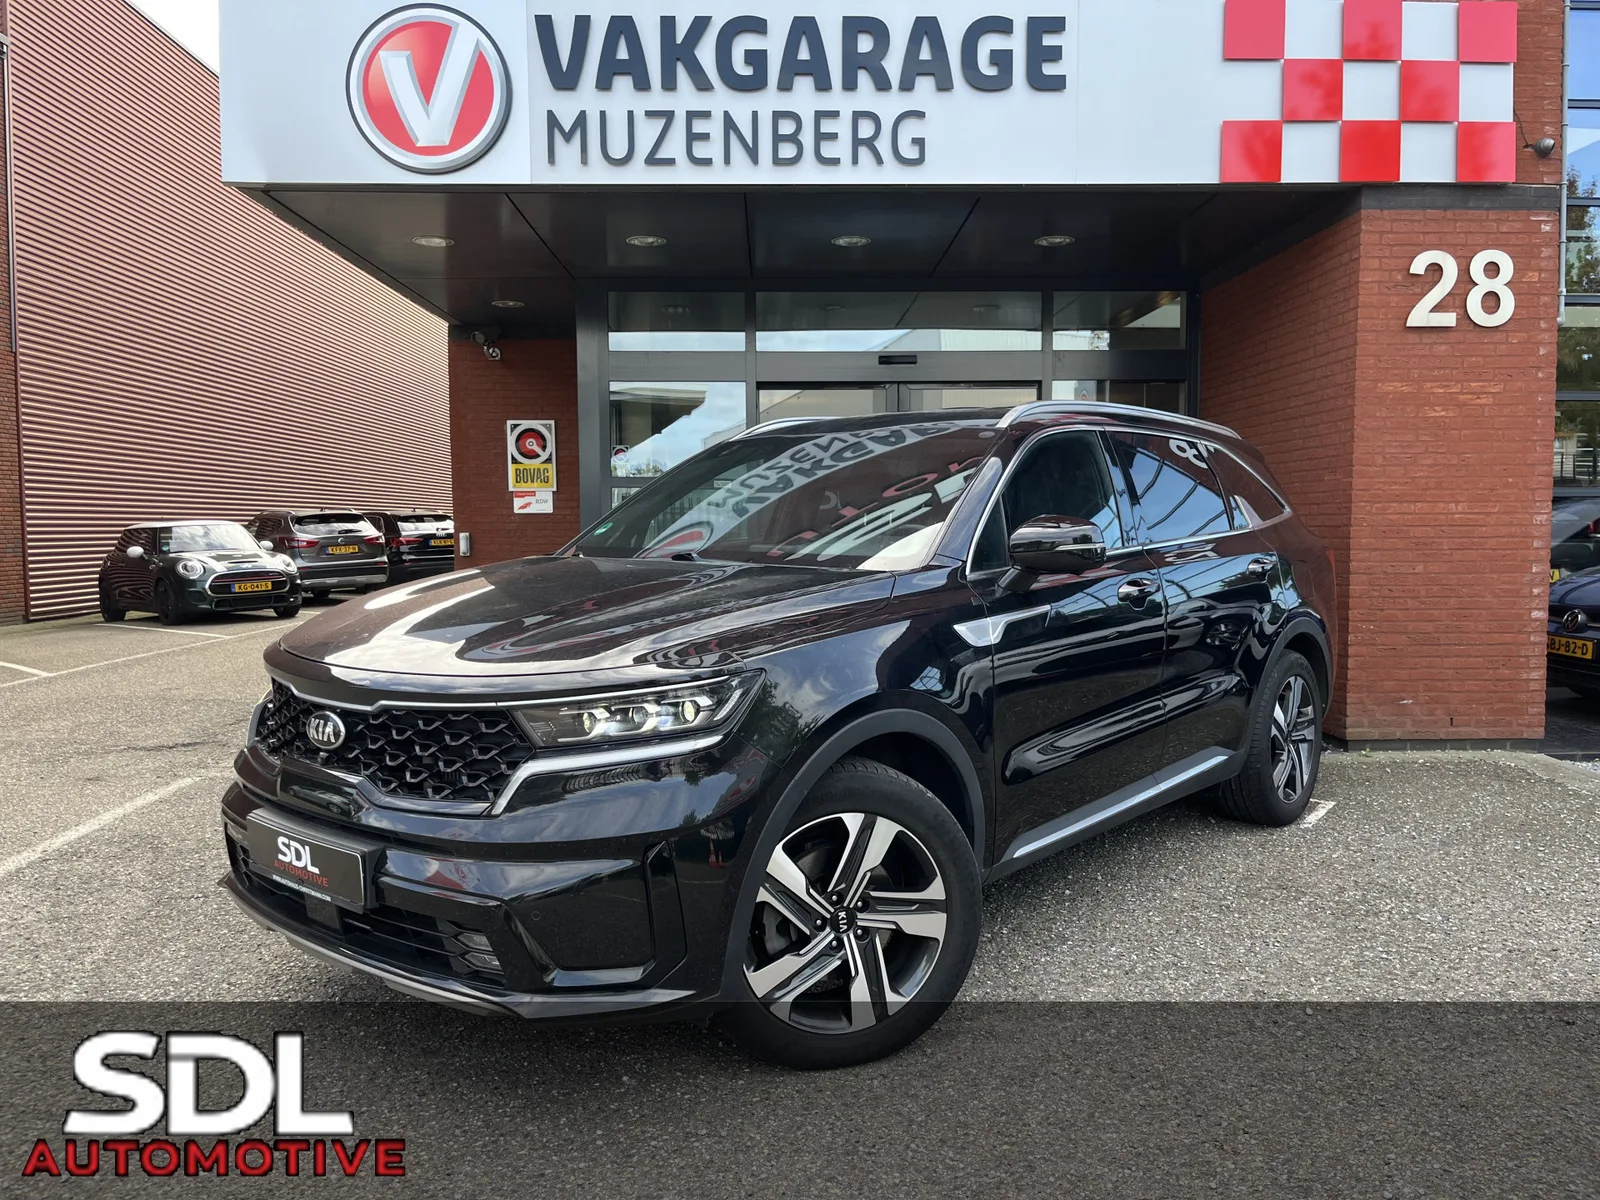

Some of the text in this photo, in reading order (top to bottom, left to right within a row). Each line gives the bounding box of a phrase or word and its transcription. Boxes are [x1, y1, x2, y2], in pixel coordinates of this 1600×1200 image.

[534, 14, 1067, 92] VAKGARAGE
[545, 109, 927, 167] MUZENBERG
[1406, 249, 1516, 328] 28
[515, 467, 550, 484] BOVAG
[238, 582, 269, 591] KG-041-S
[1547, 638, 1588, 655] BJ-82-D
[310, 717, 336, 743] KIA
[277, 835, 320, 875] SDL
[274, 859, 329, 887] AUTOMOTIVE
[837, 911, 848, 932] KIA
